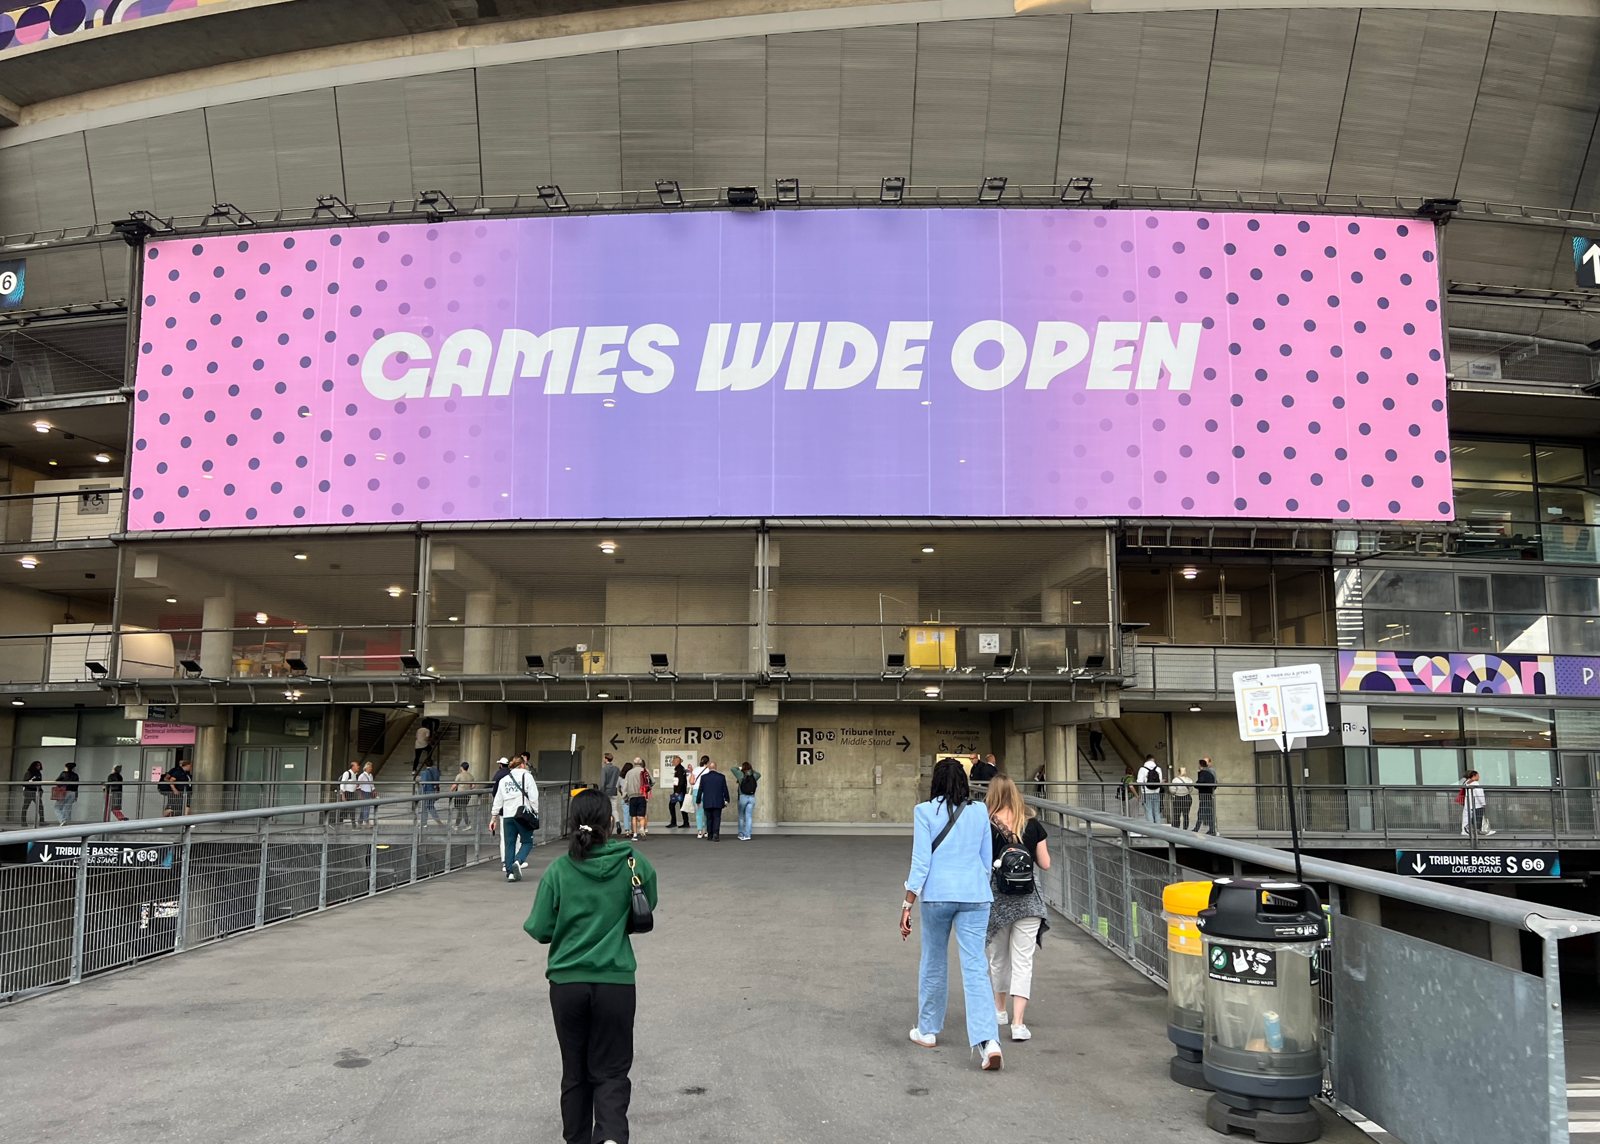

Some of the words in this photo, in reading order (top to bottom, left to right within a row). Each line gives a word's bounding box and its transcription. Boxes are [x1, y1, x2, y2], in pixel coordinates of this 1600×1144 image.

[2, 274, 12, 291] 6
[361, 323, 680, 400] GAMES
[695, 320, 933, 391] WIDE
[951, 319, 1202, 391] OPEN
[625, 726, 659, 735] Tribune
[660, 726, 682, 735] Inter
[686, 728, 700, 745] R
[840, 728, 874, 736] Tribune
[875, 728, 896, 737] Inter
[629, 735, 657, 744] Middle
[658, 735, 682, 745] Stand
[799, 730, 812, 745] R
[840, 737, 867, 746] Middle
[868, 737, 891, 746] Stand
[799, 750, 812, 765] R
[92, 847, 119, 856] BASSE
[123, 847, 134, 864] R
[1429, 855, 1468, 865] TRIBUNE
[1471, 855, 1501, 866] BASSE
[1506, 856, 1518, 874] S
[1451, 865, 1477, 874] LOWER
[1478, 865, 1501, 874] STAND
